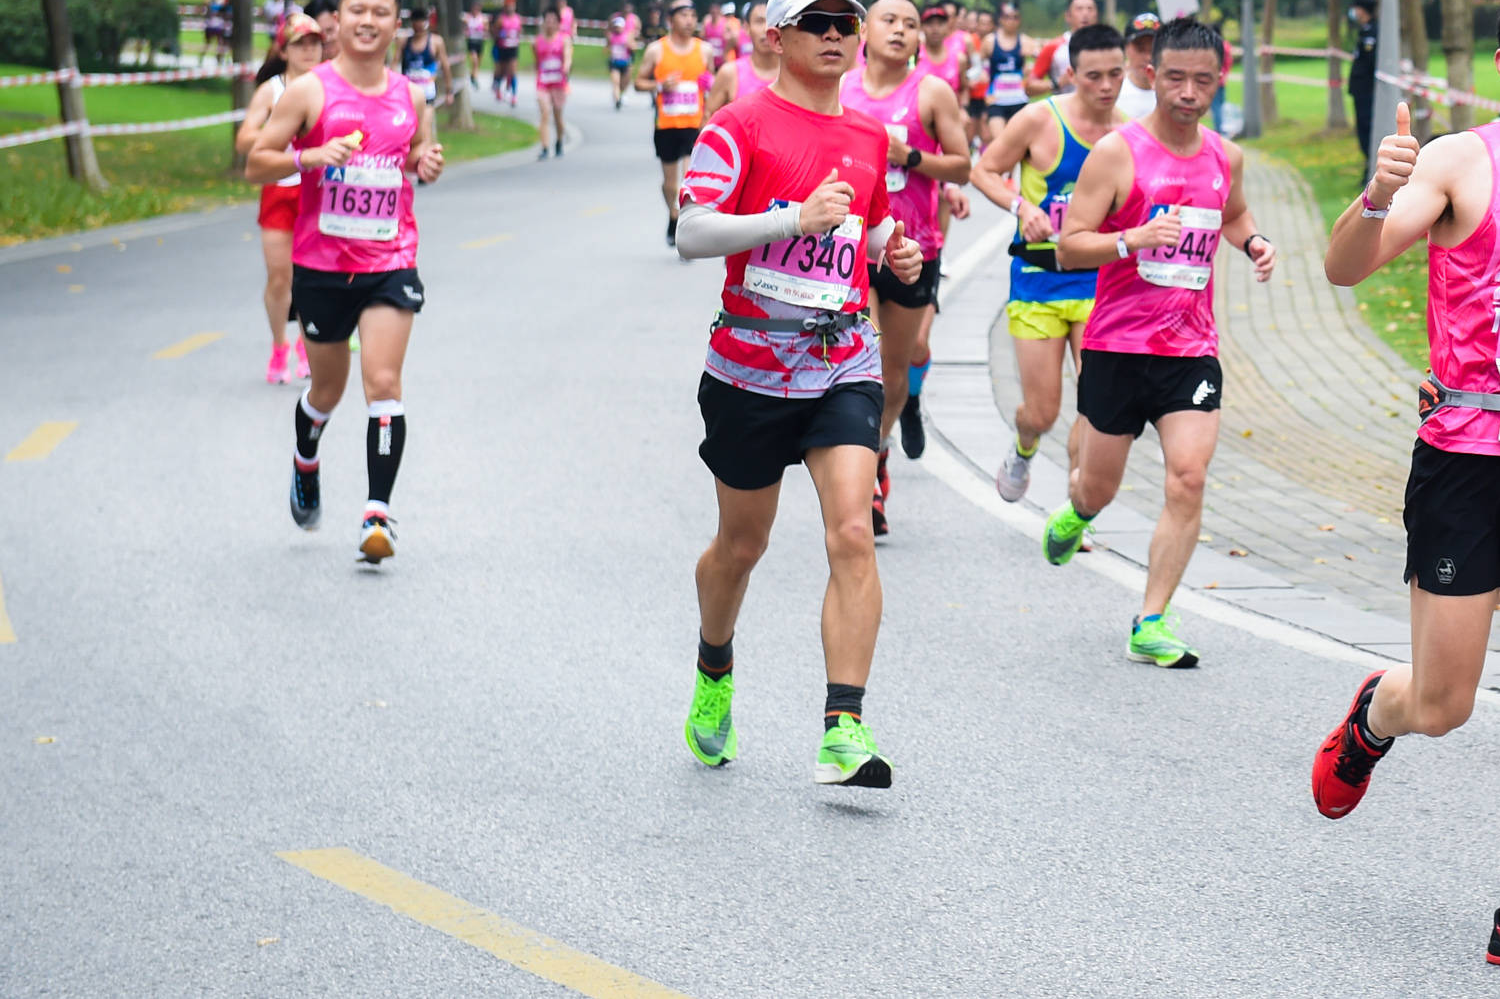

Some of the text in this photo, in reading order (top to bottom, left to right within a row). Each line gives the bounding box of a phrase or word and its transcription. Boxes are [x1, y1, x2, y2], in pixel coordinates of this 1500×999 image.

[332, 168, 342, 181] A
[329, 185, 397, 217] 16379
[761, 235, 856, 280] 17340
